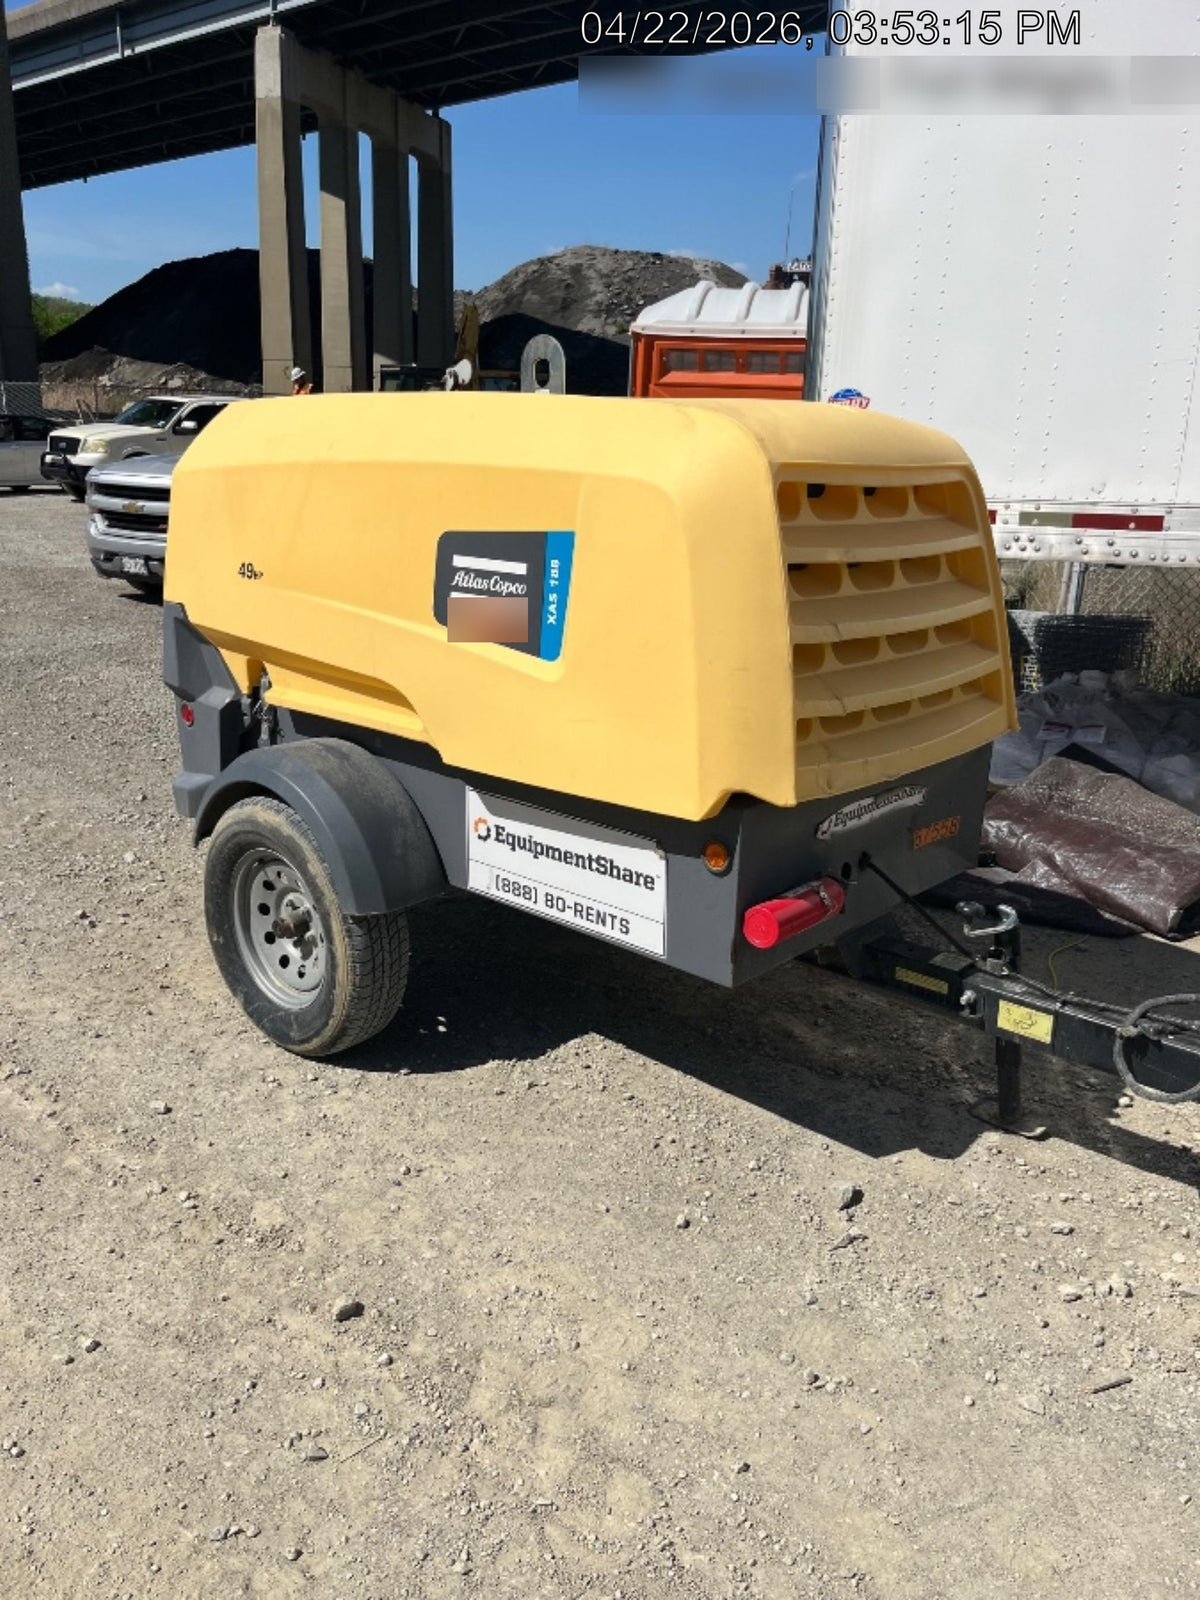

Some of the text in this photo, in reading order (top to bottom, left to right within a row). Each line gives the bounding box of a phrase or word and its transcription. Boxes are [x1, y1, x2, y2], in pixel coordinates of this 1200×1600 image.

[547, 593, 558, 625] XAS
[493, 823, 656, 890] EquipmentShare
[495, 874, 538, 904] (888)
